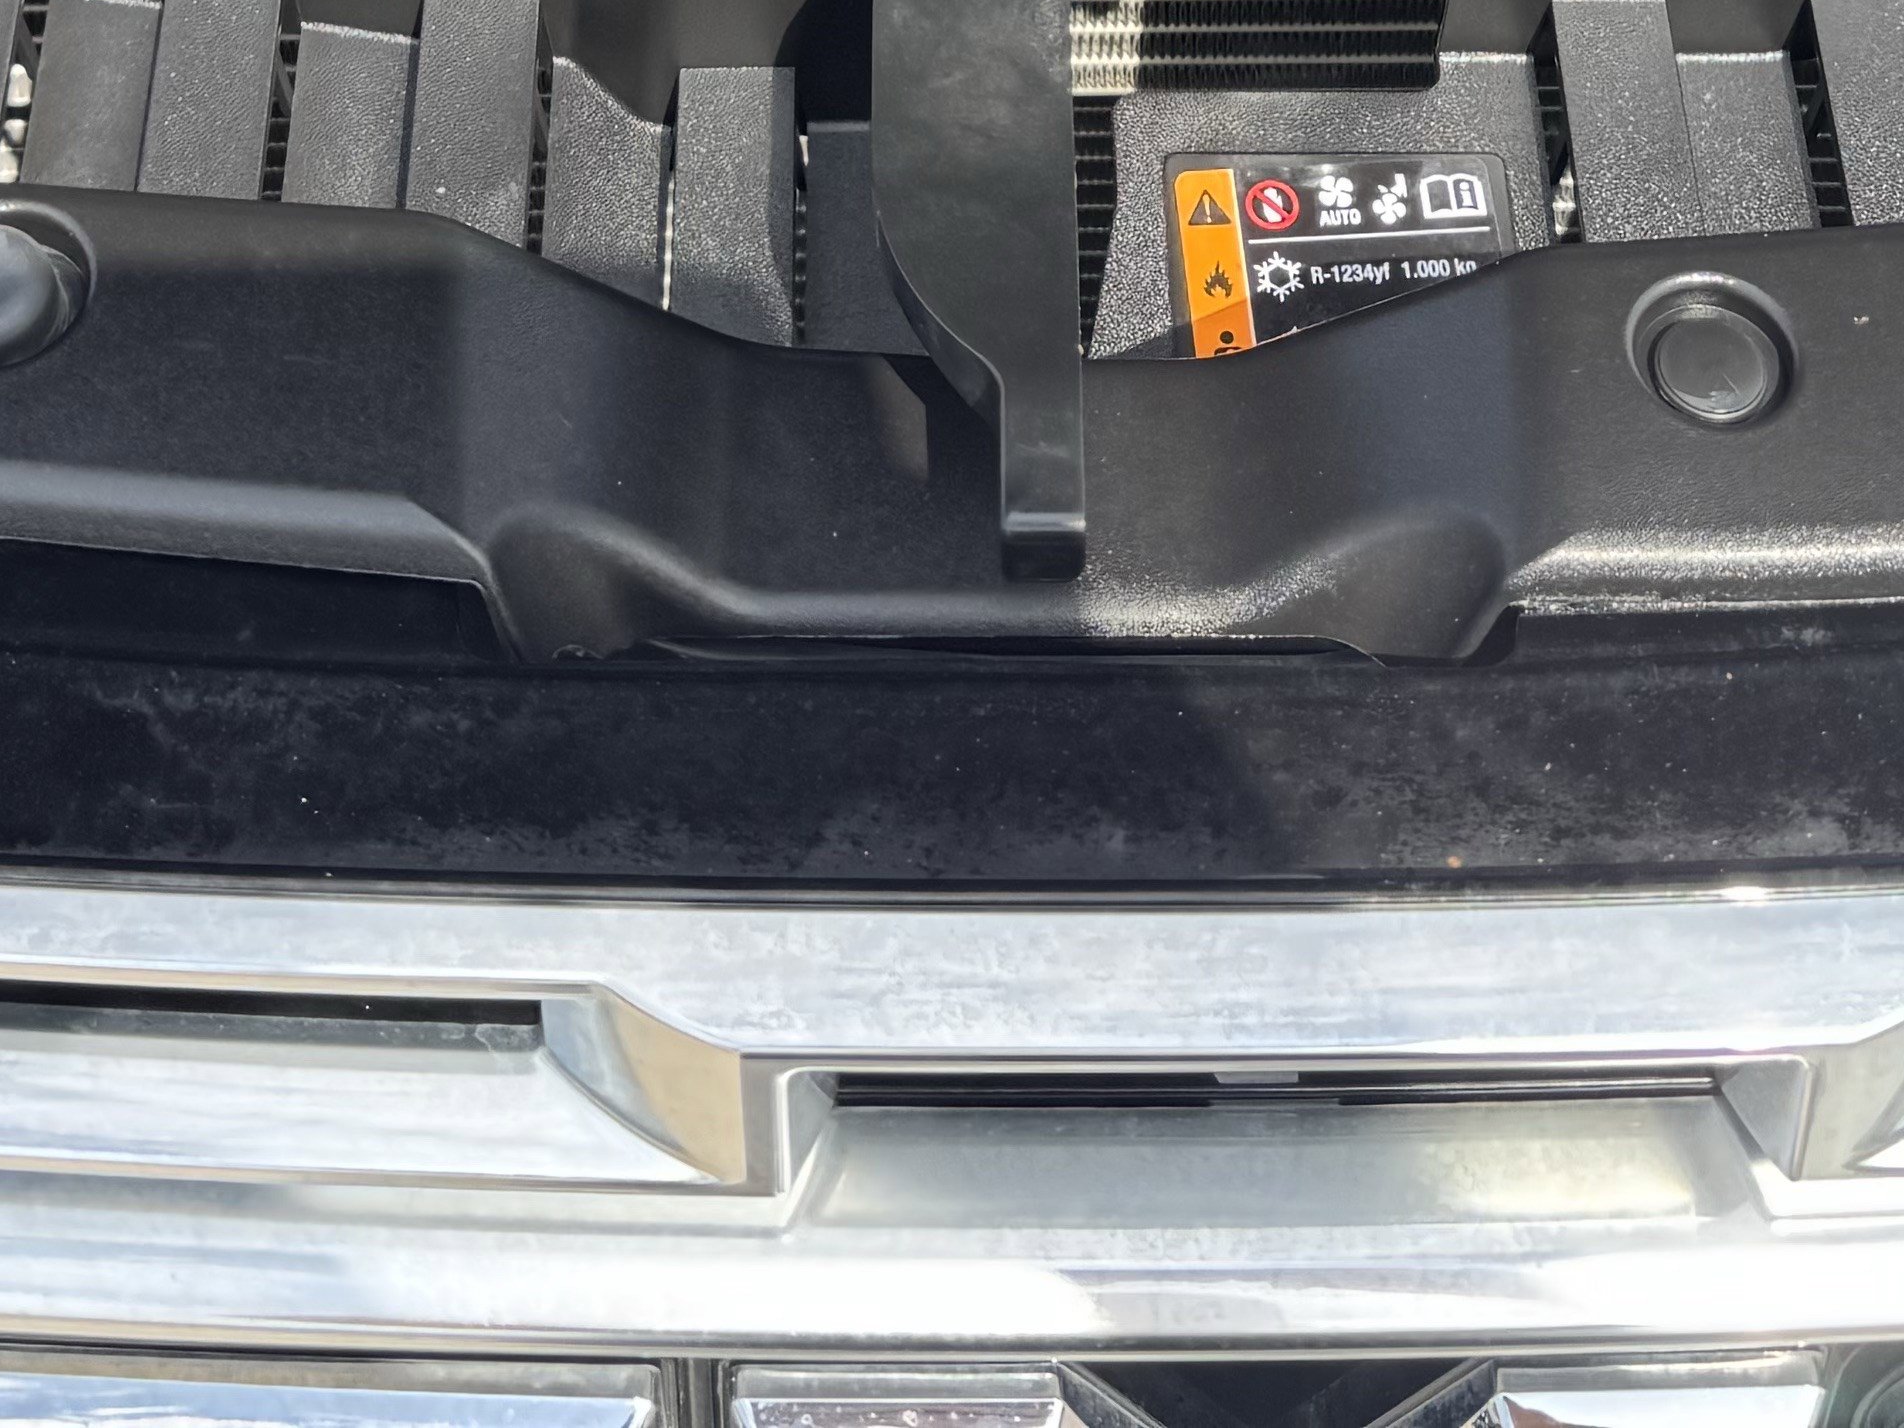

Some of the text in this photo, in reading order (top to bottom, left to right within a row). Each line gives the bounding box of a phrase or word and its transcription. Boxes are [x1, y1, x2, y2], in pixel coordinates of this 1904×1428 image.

[1319, 208, 1362, 227] AUTO
[1310, 261, 1390, 285] R-1234yf
[1401, 258, 1450, 279] 1.000
